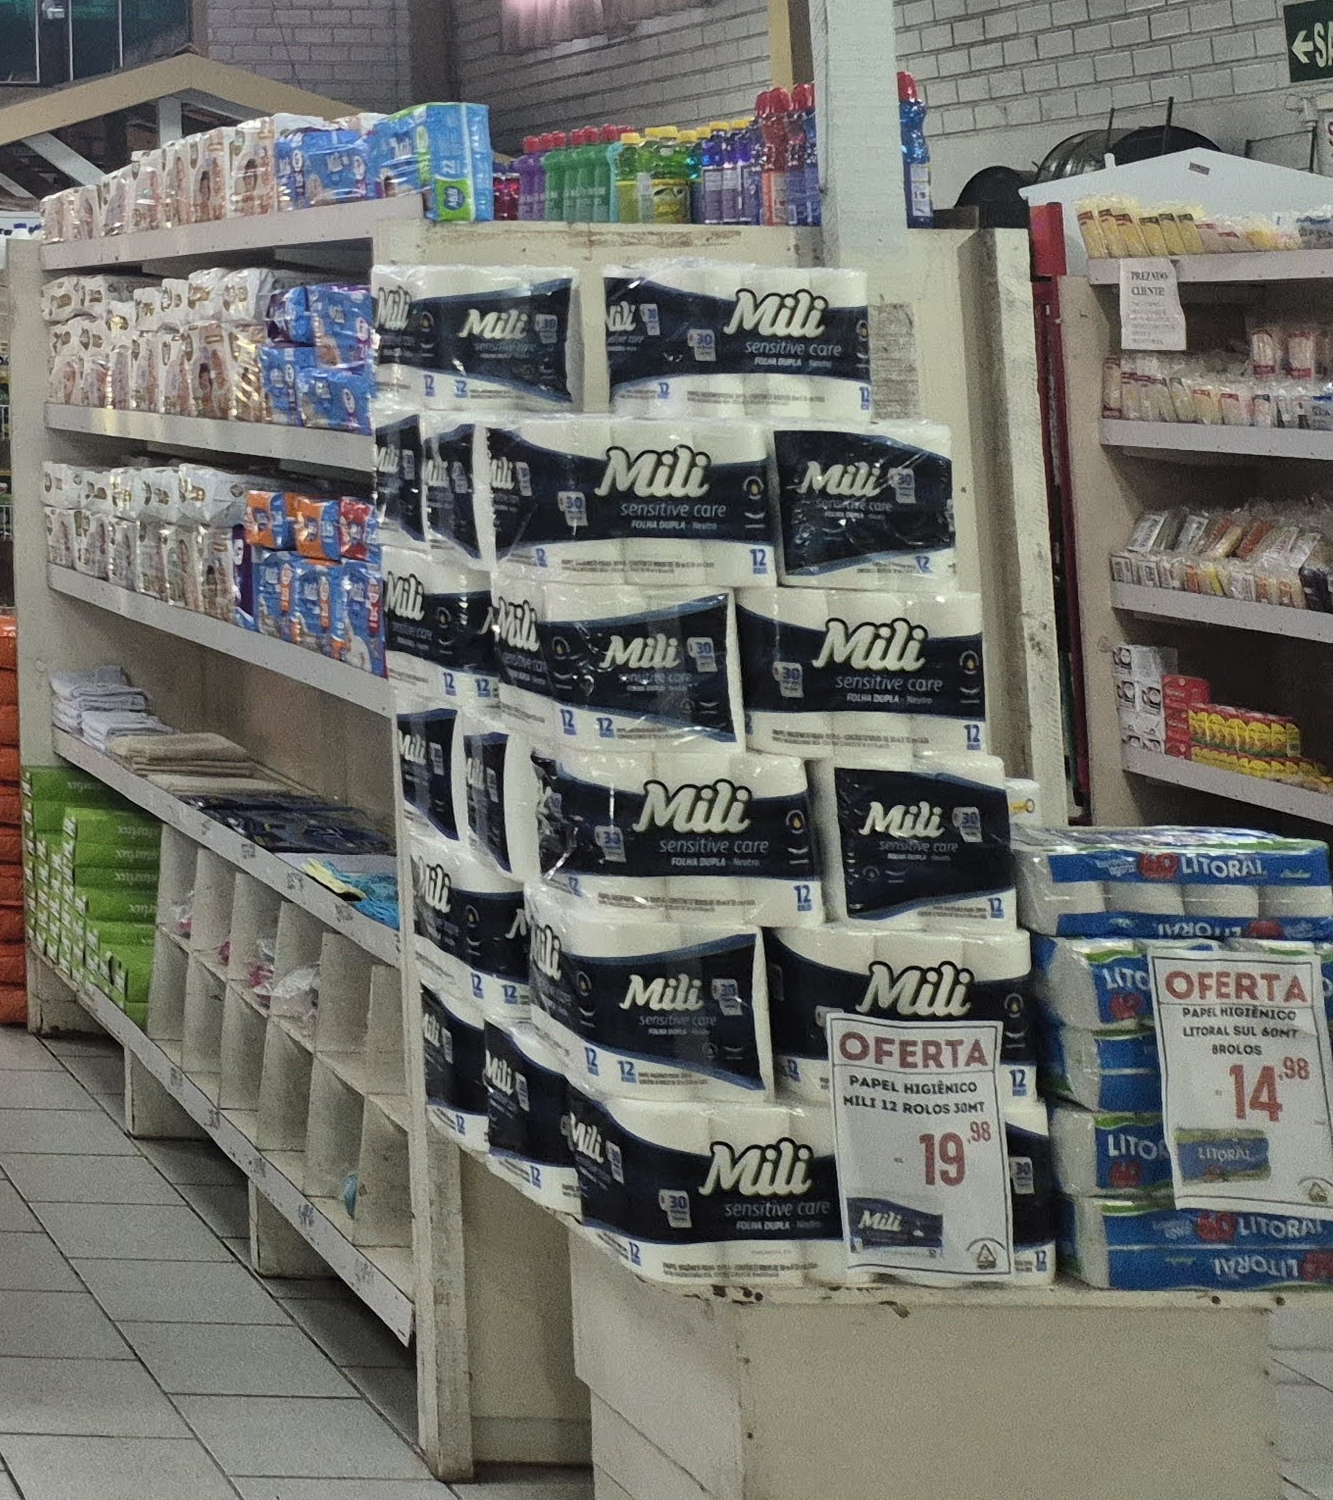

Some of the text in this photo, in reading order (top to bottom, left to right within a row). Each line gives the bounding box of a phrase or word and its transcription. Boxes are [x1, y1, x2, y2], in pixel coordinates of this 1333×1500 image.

[1131, 270, 1169, 281] PREZADO
[1132, 286, 1165, 296] CLIENTE
[723, 287, 829, 339] Mili
[457, 308, 530, 340] Mili
[745, 340, 842, 357] sensitive care
[594, 443, 712, 499] Mili
[796, 460, 883, 498] Mili
[620, 501, 727, 518] sensitive care
[749, 548, 767, 567] 12
[384, 570, 426, 622] Mili
[599, 633, 681, 669] Mili
[695, 641, 712, 654] 30
[811, 617, 929, 673] Mili
[443, 672, 455, 688] 12
[782, 667, 801, 680] 30
[835, 674, 943, 692] sensitive care
[475, 678, 491, 692] 12
[561, 709, 575, 728] 12
[596, 717, 614, 732] 12
[963, 724, 981, 743] 12
[633, 778, 753, 834] Mili
[858, 800, 946, 839] Mili
[962, 811, 980, 825] 30
[659, 838, 770, 854] sensitive care
[933, 842, 959, 853] care
[671, 857, 699, 866] FOLHA
[793, 884, 812, 904] 12
[989, 897, 1003, 912] 12
[470, 972, 483, 989] 12
[855, 960, 976, 1017] Mili
[1102, 967, 1152, 992] LITO
[1164, 970, 1308, 1003] OFERTA
[502, 984, 518, 1001] 12
[619, 973, 705, 1011] Mili
[691, 1015, 717, 1026] care
[1183, 1003, 1297, 1022] PAPEL HIGIÊNICO
[1183, 1025, 1300, 1039] LITORAL SUL 60MT
[585, 1046, 598, 1069] 12
[838, 1030, 990, 1070] OFERTA
[618, 1060, 636, 1077] 12
[849, 1075, 978, 1095] PAPEL HIGIÊNICO
[1009, 1069, 1027, 1088] 12
[843, 1095, 986, 1115] MILI 12 ROLOS 30MT
[455, 1113, 466, 1131] 12
[1107, 1133, 1170, 1161] LITO
[530, 1166, 541, 1183] 12
[698, 1136, 814, 1197] Mili
[1015, 1162, 1032, 1176] 30
[669, 1195, 688, 1210] 30
[725, 1199, 831, 1218] sensitive care
[736, 1220, 763, 1230] FOLHA
[858, 1209, 903, 1232] Mili
[1034, 1250, 1047, 1264] 12
